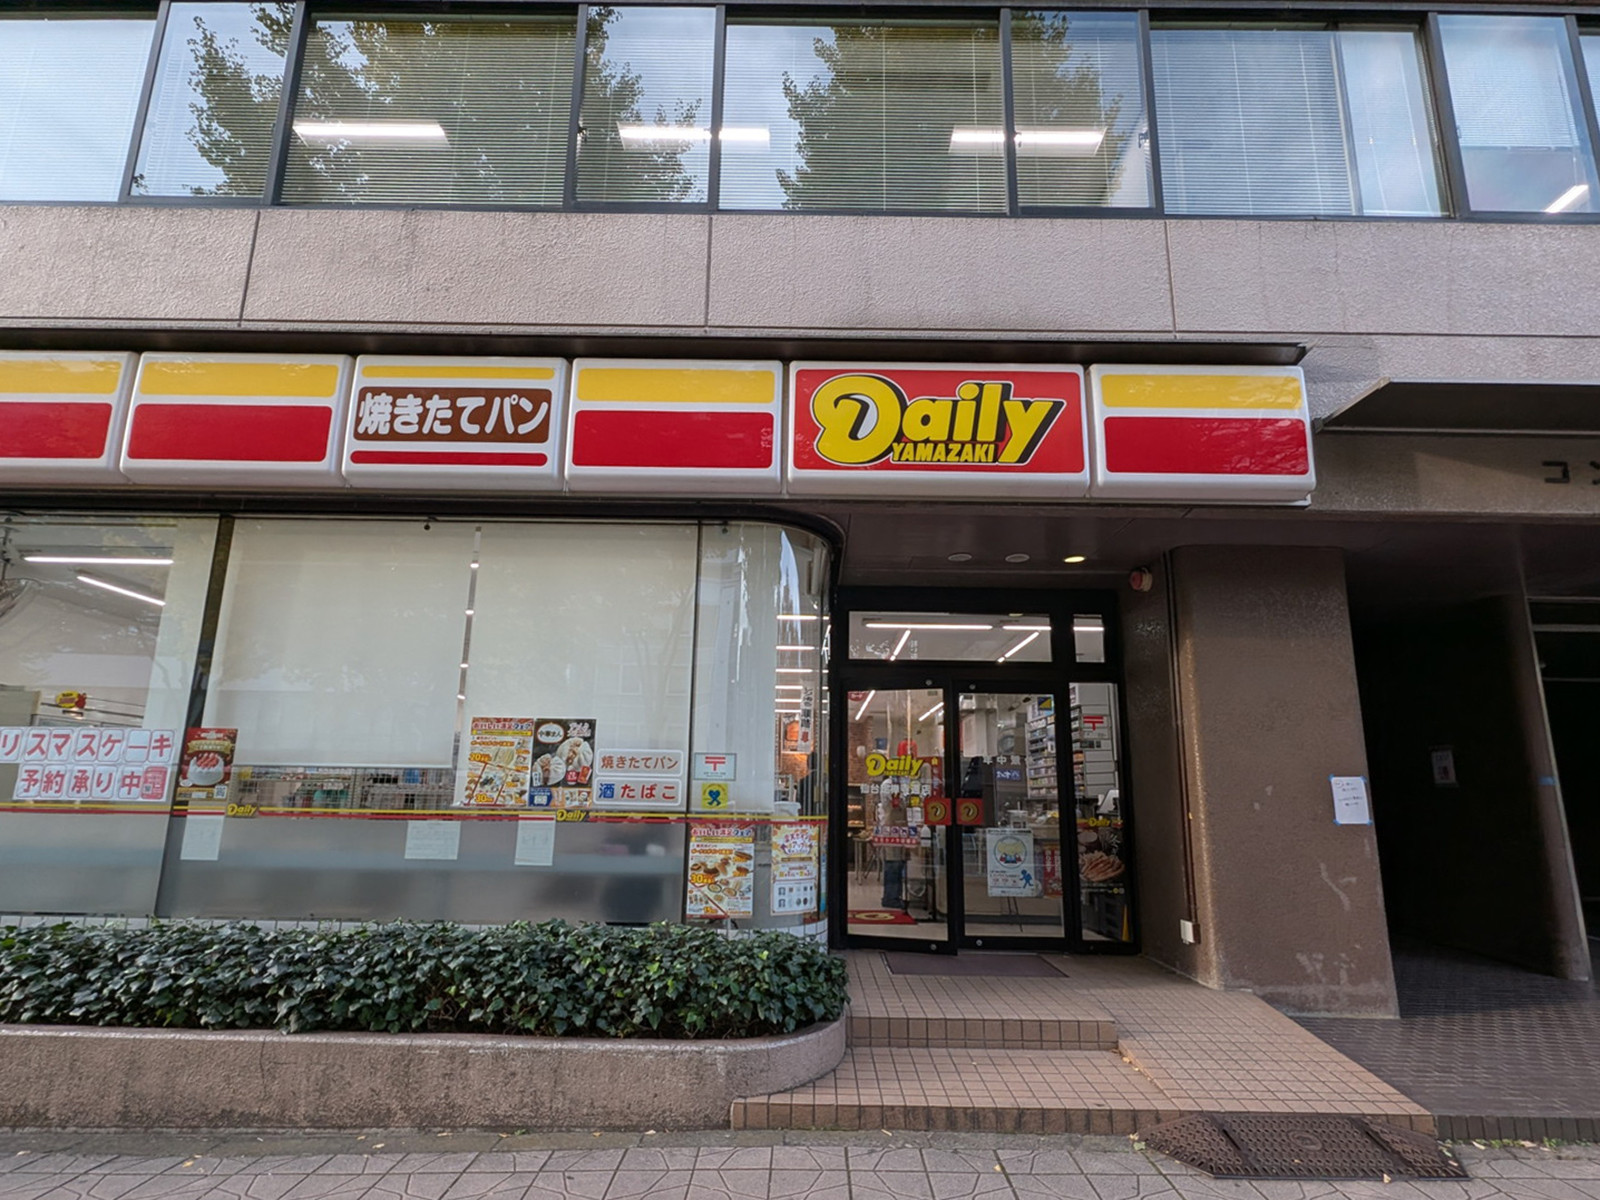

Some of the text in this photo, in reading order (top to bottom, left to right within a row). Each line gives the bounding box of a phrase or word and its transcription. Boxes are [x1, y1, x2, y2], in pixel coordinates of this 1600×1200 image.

[357, 391, 549, 435] 焼きたてパン
[813, 375, 1065, 464] Daily
[892, 443, 996, 463] YAMAZAKI
[1, 732, 173, 758] リスマスケーキ
[600, 755, 679, 770] 焼きたてパン
[866, 753, 923, 776] Daily
[20, 769, 142, 796] 予約承り中
[599, 783, 677, 800] 酒 たばこ
[228, 804, 257, 816] Daily
[557, 809, 586, 822] Daily
